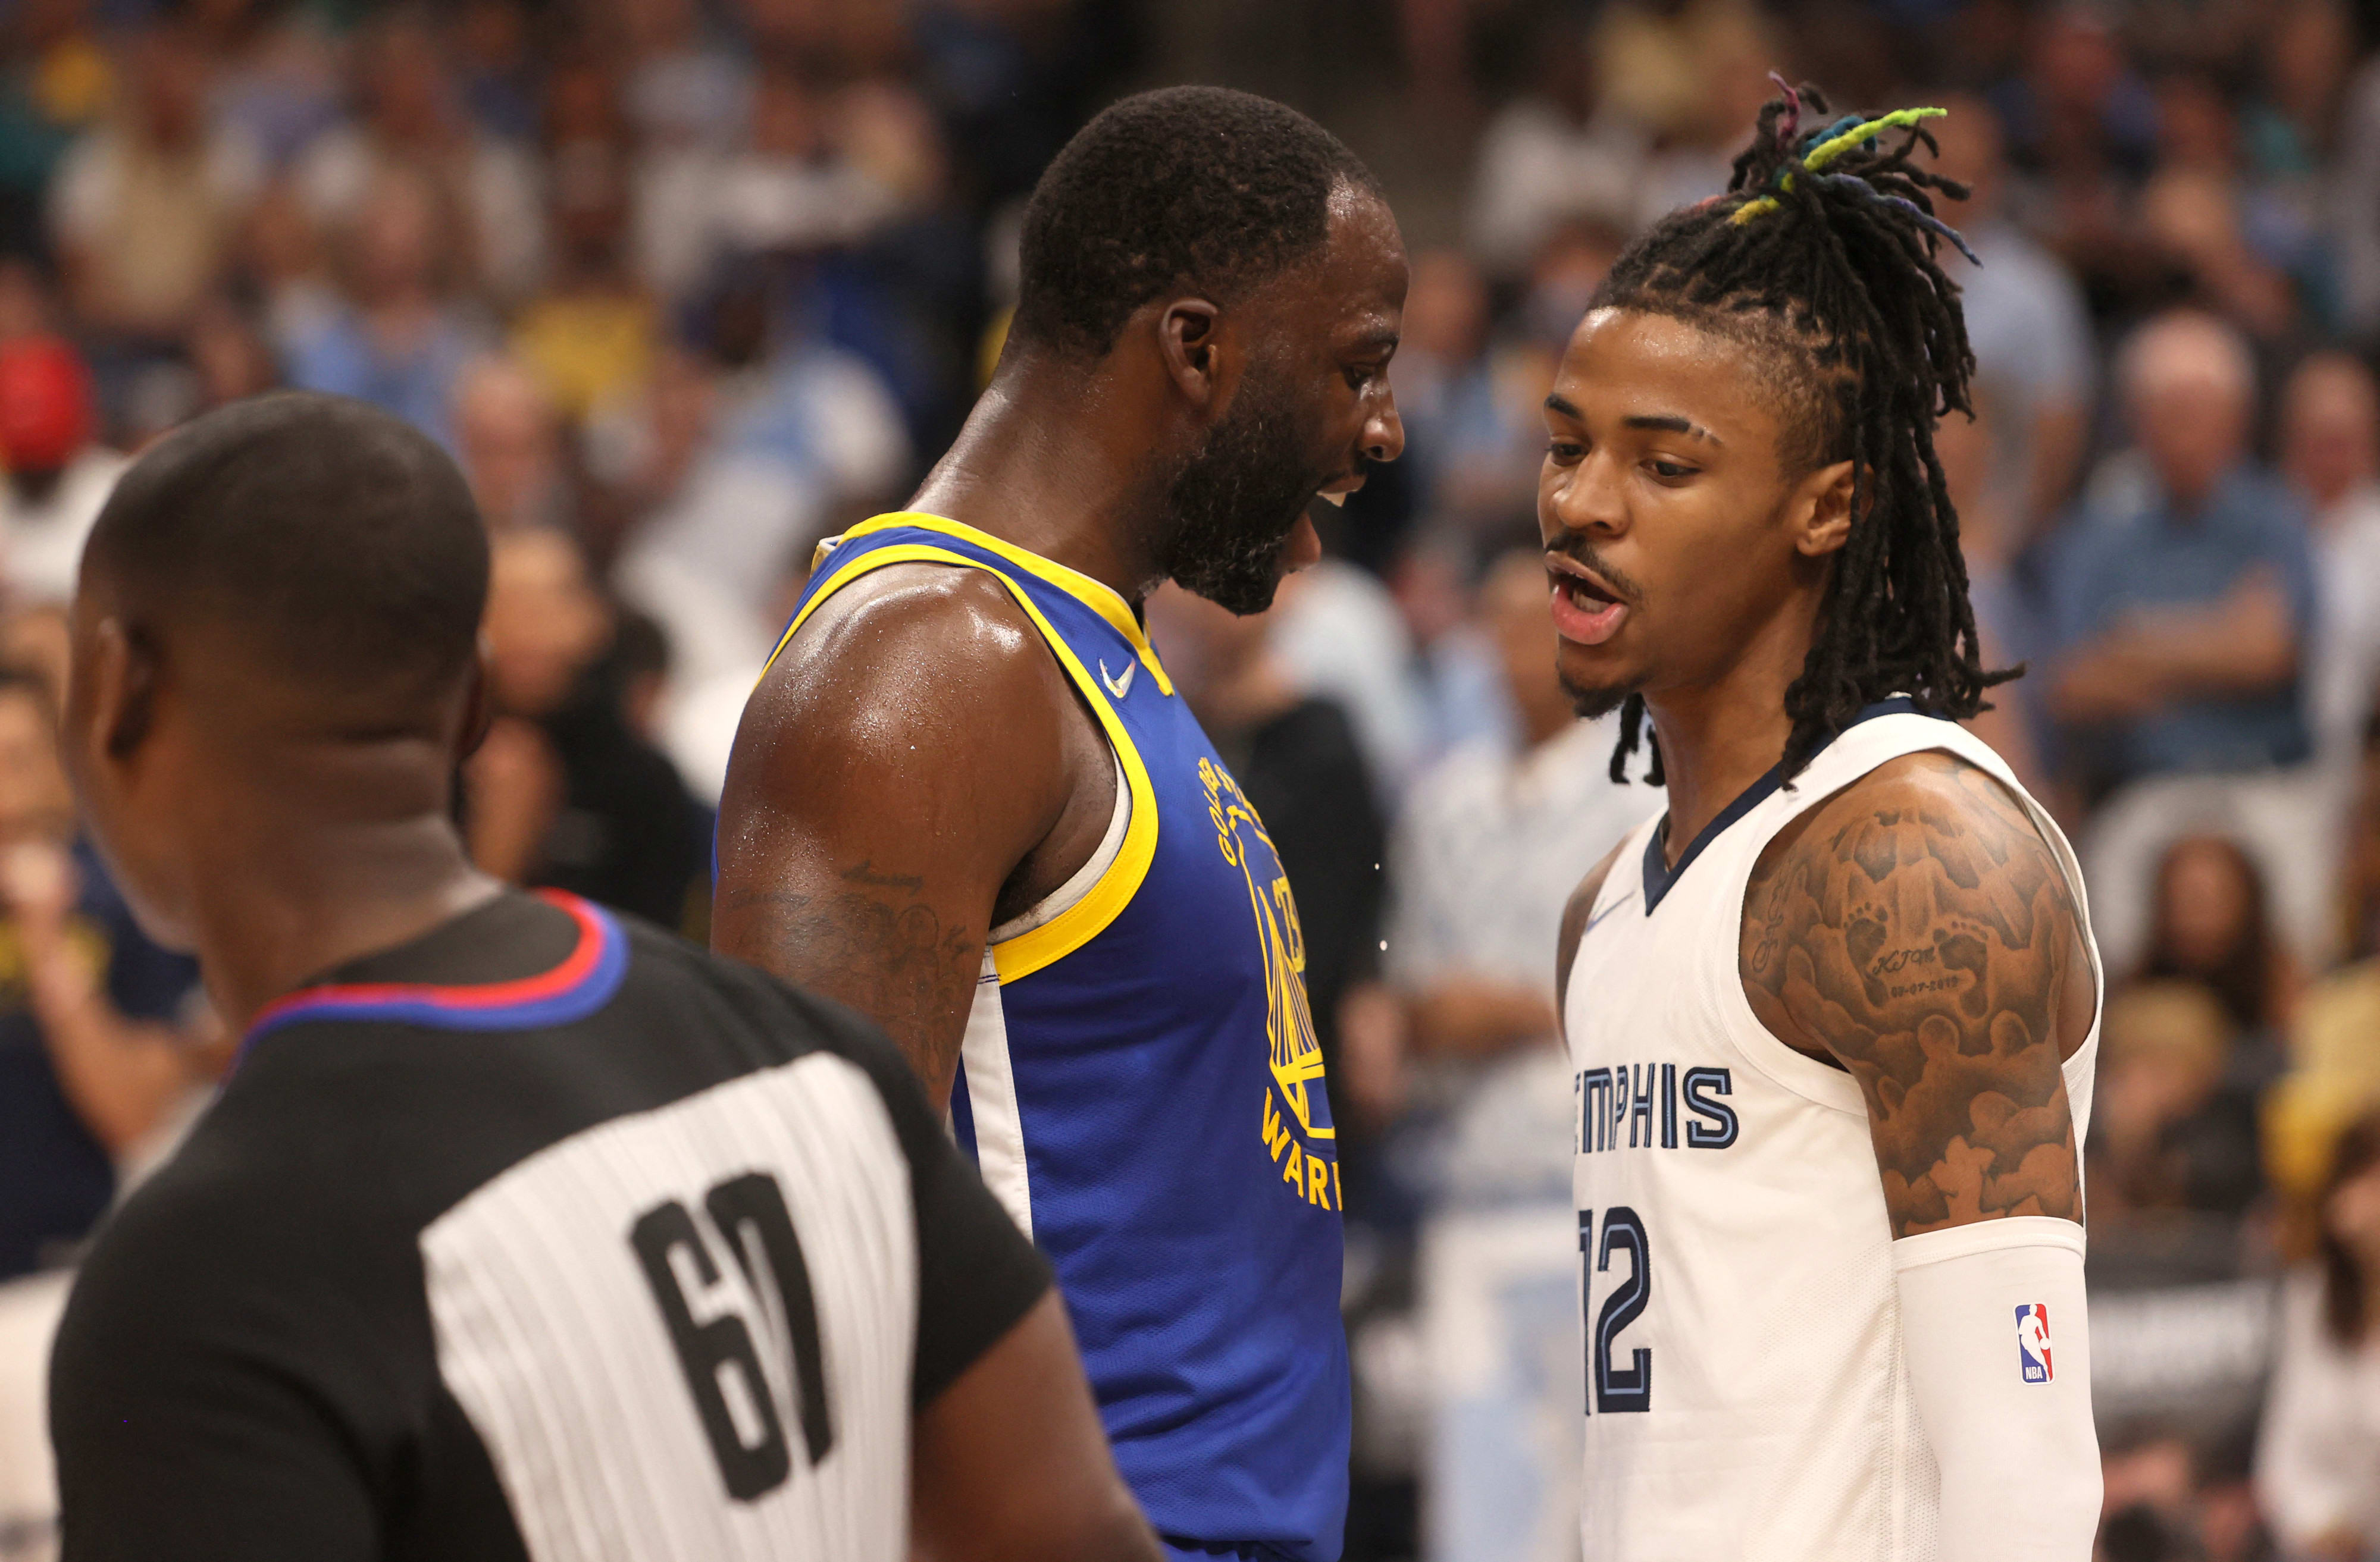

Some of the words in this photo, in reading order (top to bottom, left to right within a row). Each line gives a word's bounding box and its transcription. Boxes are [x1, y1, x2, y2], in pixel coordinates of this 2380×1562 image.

[1574, 1062, 1739, 1155] MPHIS
[1578, 1206, 1652, 1416] 12
[2025, 1366, 2043, 1380] NBA
